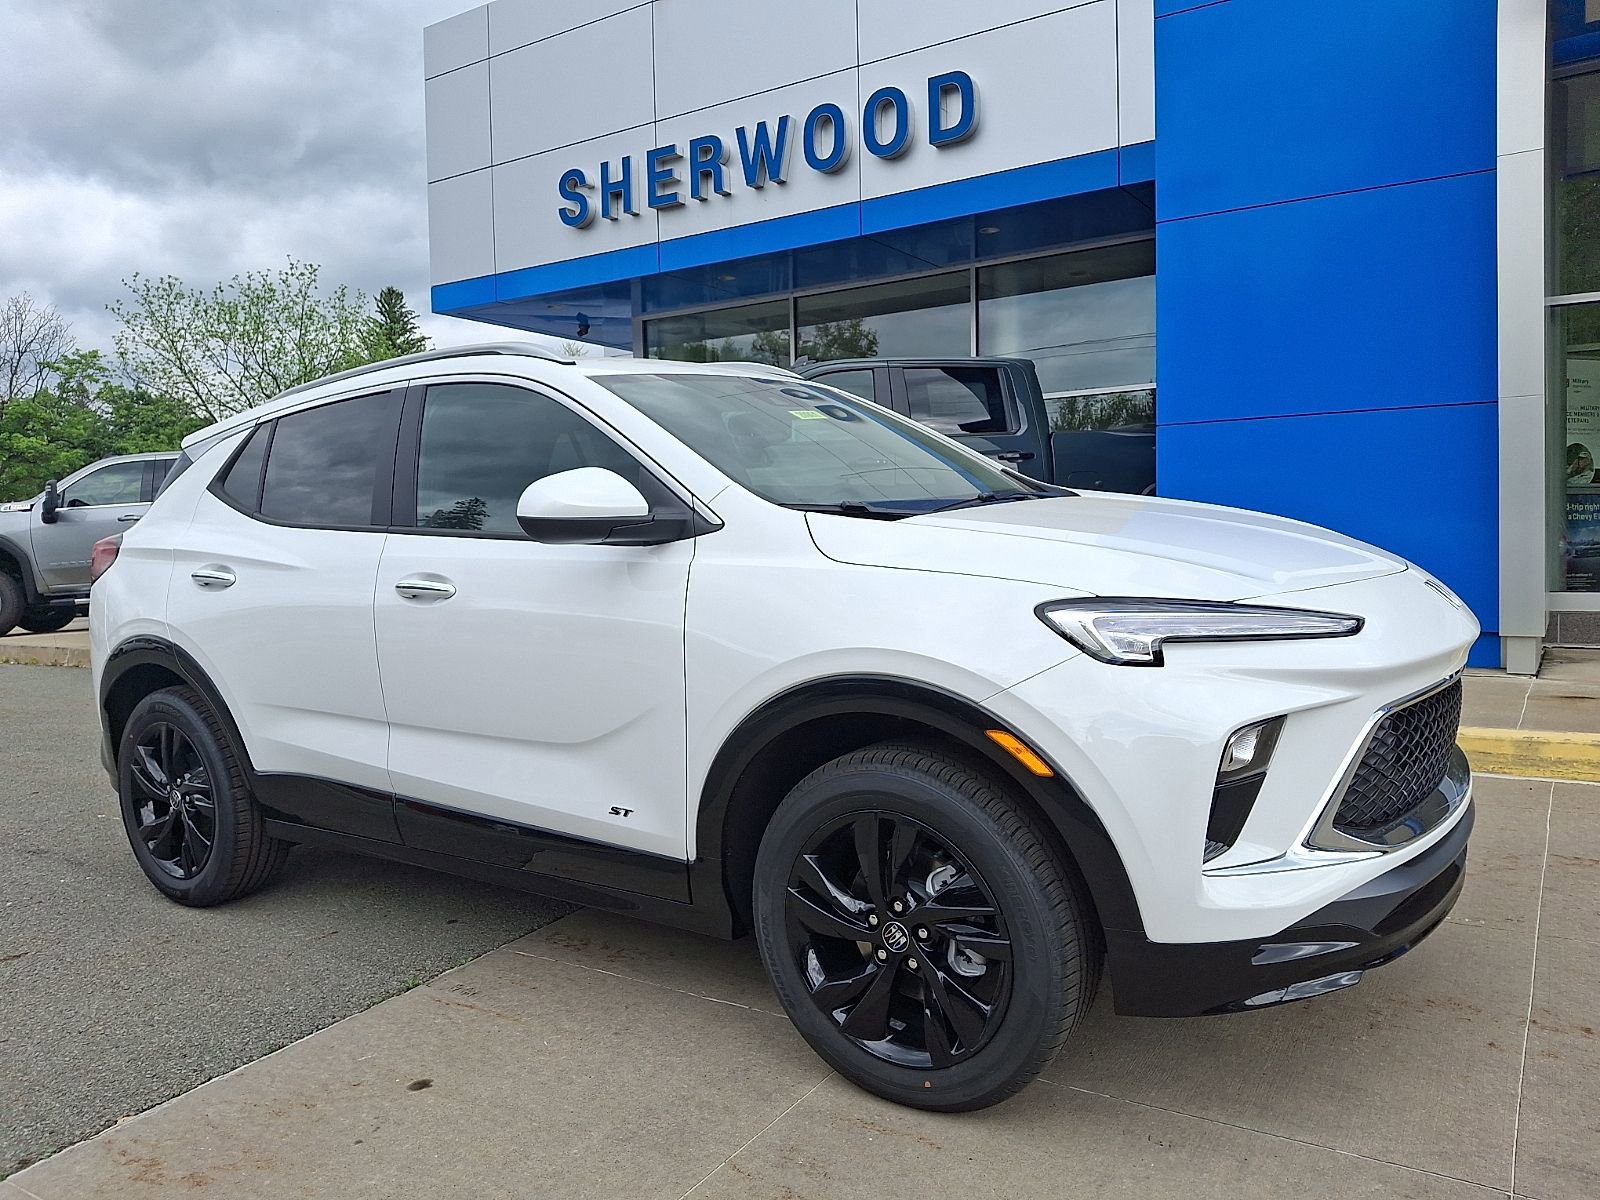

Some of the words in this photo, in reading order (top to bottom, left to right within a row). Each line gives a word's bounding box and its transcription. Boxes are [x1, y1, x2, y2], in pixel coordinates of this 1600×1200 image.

[558, 70, 978, 228] SHERWOOD
[1572, 513, 1593, 522] Chevy
[609, 806, 634, 817] ST
